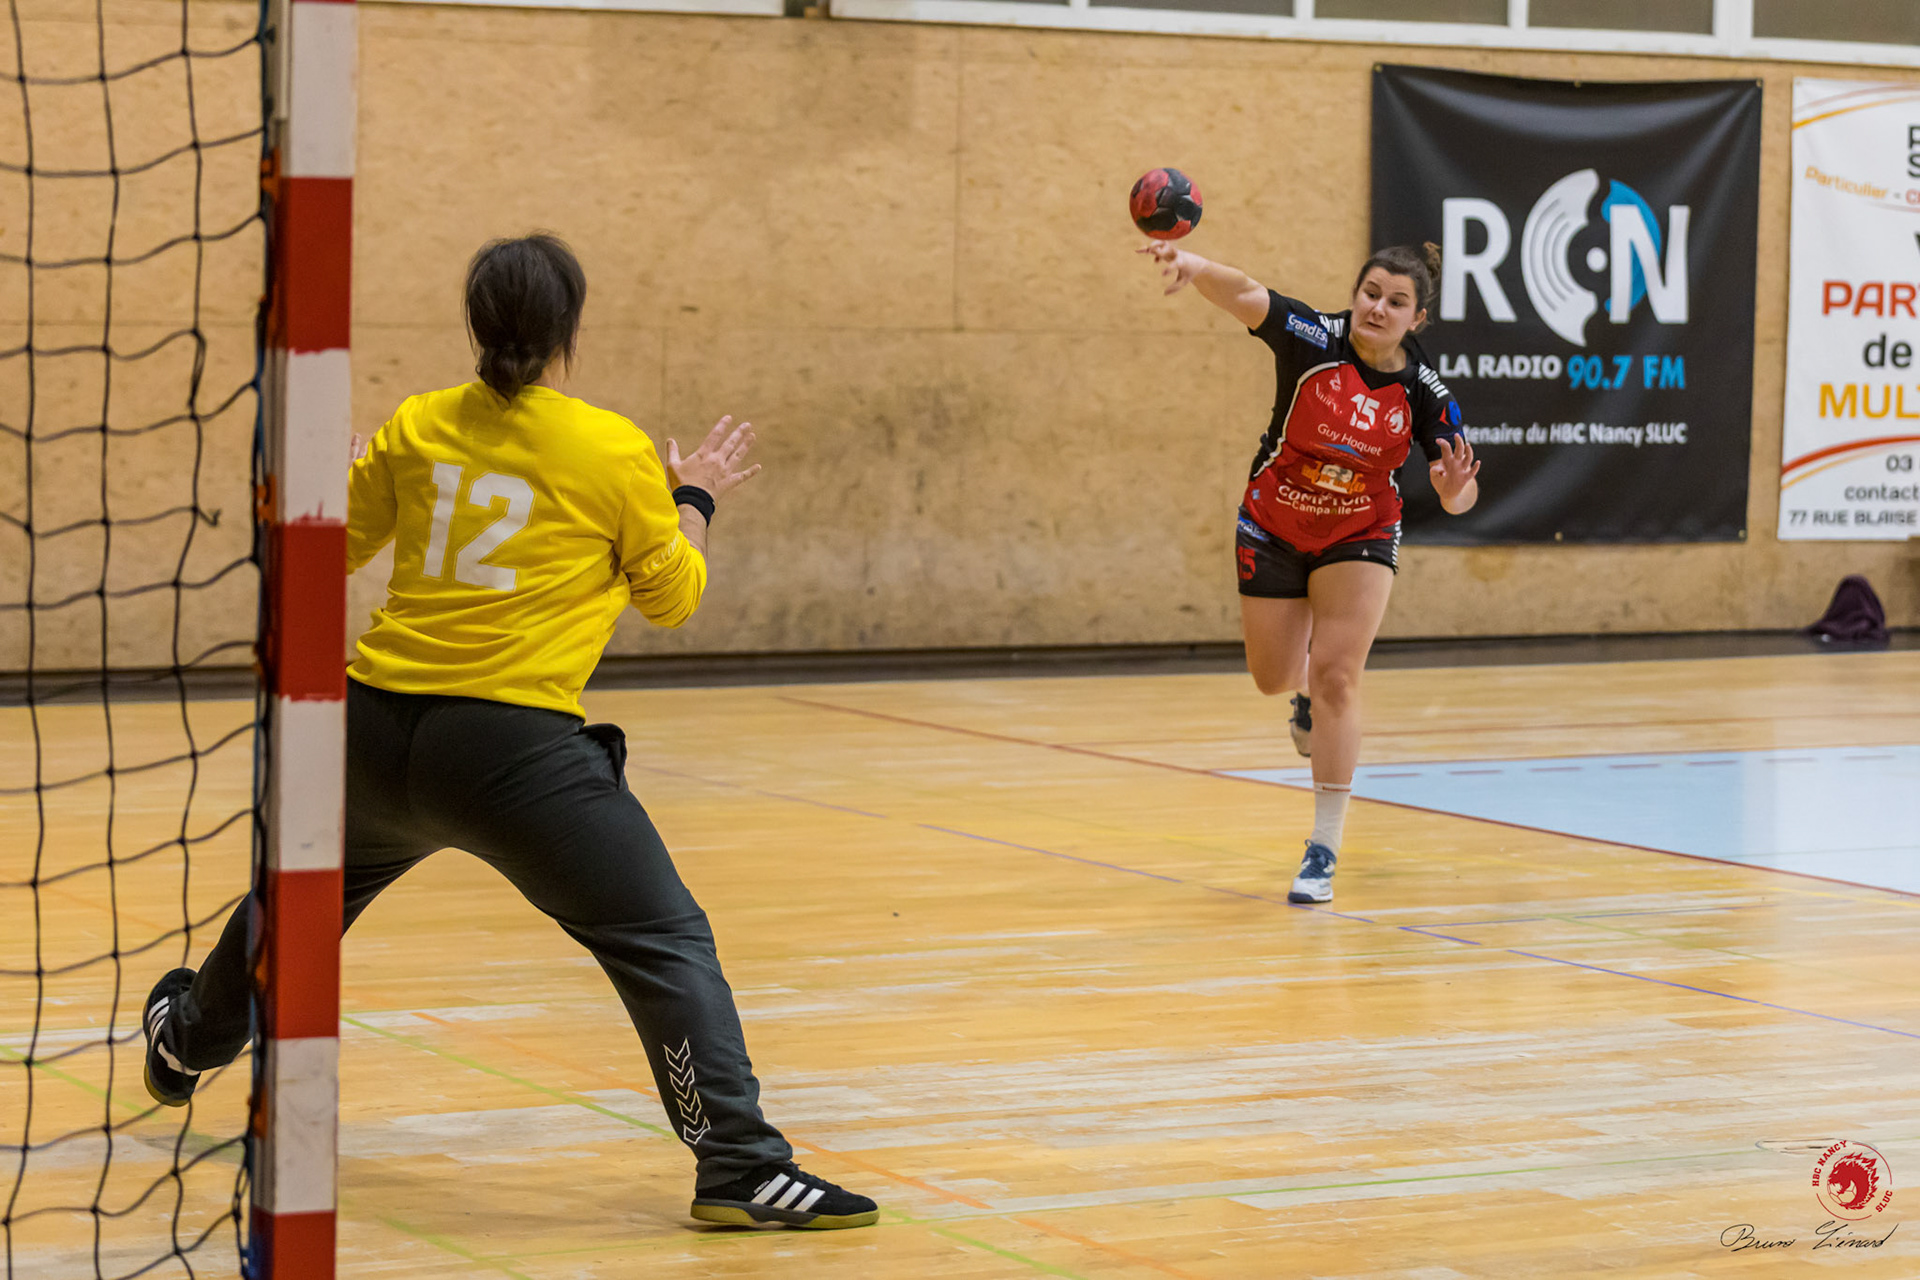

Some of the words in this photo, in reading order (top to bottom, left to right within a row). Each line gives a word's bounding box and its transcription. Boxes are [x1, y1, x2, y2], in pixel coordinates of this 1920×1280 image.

[1804, 165, 1889, 199] Particulier
[1822, 281, 1920, 318] PAR
[1863, 333, 1912, 368] de
[1440, 354, 1472, 378] LA
[1477, 354, 1562, 379] RADIO
[1567, 355, 1633, 389] 90.7
[1643, 355, 1686, 389] FM
[1350, 393, 1381, 431] 15
[1819, 383, 1920, 418] MUL
[1317, 423, 1341, 441] Guy
[1341, 433, 1383, 457] Hoquet
[1462, 422, 1523, 445] tenaire
[1525, 422, 1548, 445] du
[1549, 422, 1587, 445] HBC
[1589, 422, 1643, 448] Nancy
[1644, 422, 1688, 445] SLUC
[421, 459, 537, 592] 12
[1789, 509, 1808, 527] 77
[1813, 509, 1849, 527] RUE
[1854, 509, 1917, 527] BLAISE
